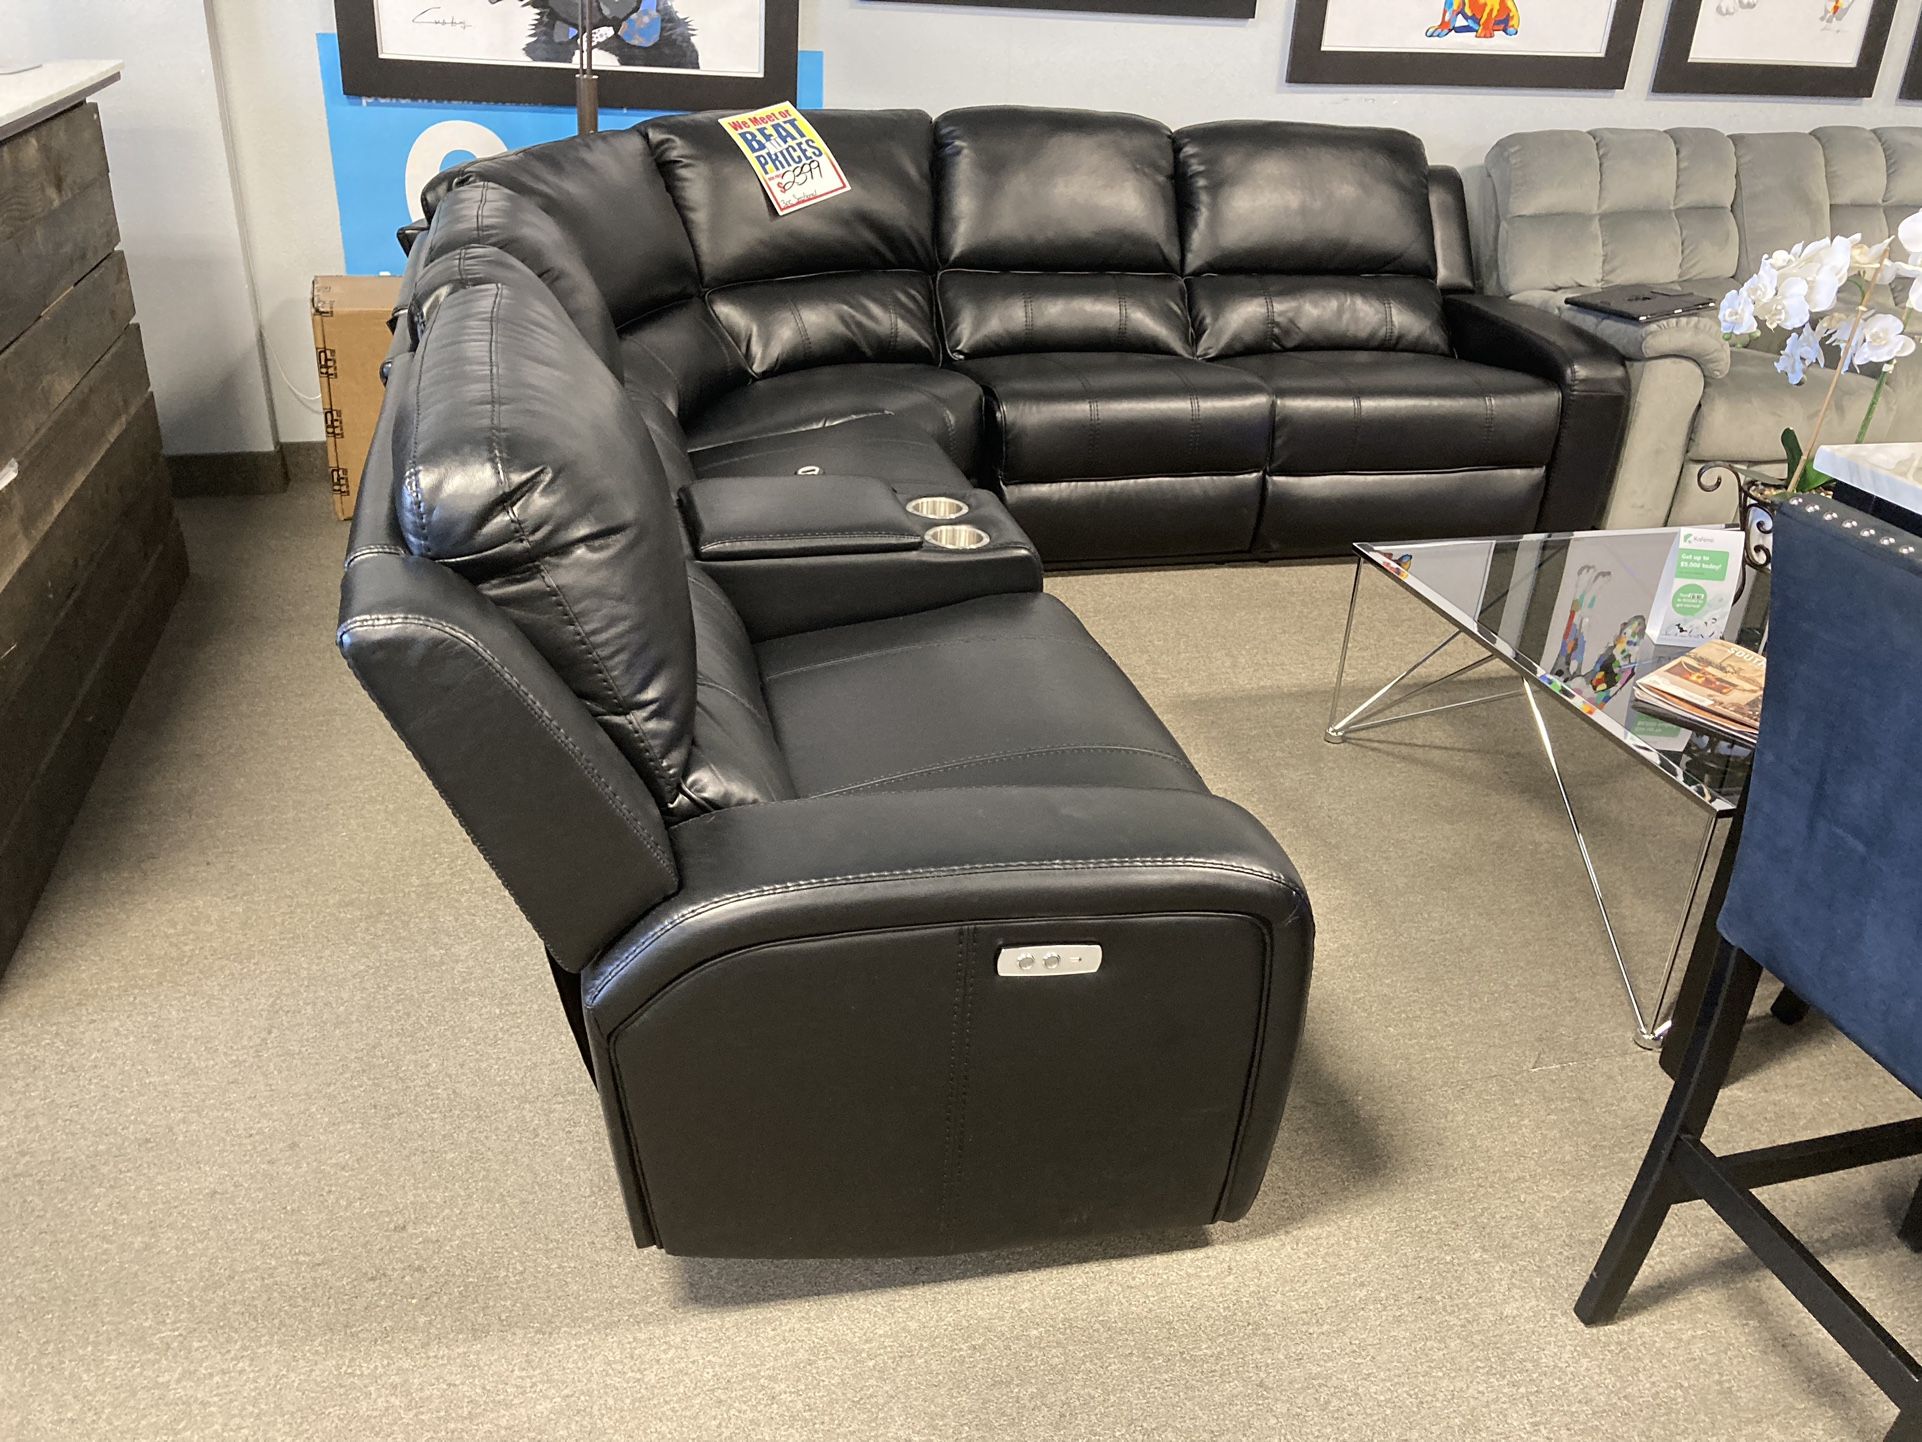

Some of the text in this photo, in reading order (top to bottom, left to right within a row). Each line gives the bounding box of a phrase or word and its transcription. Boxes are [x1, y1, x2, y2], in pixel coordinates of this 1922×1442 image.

[728, 109, 792, 132] We Meet or
[737, 118, 807, 154] BEAT
[755, 138, 824, 175] PRICES
